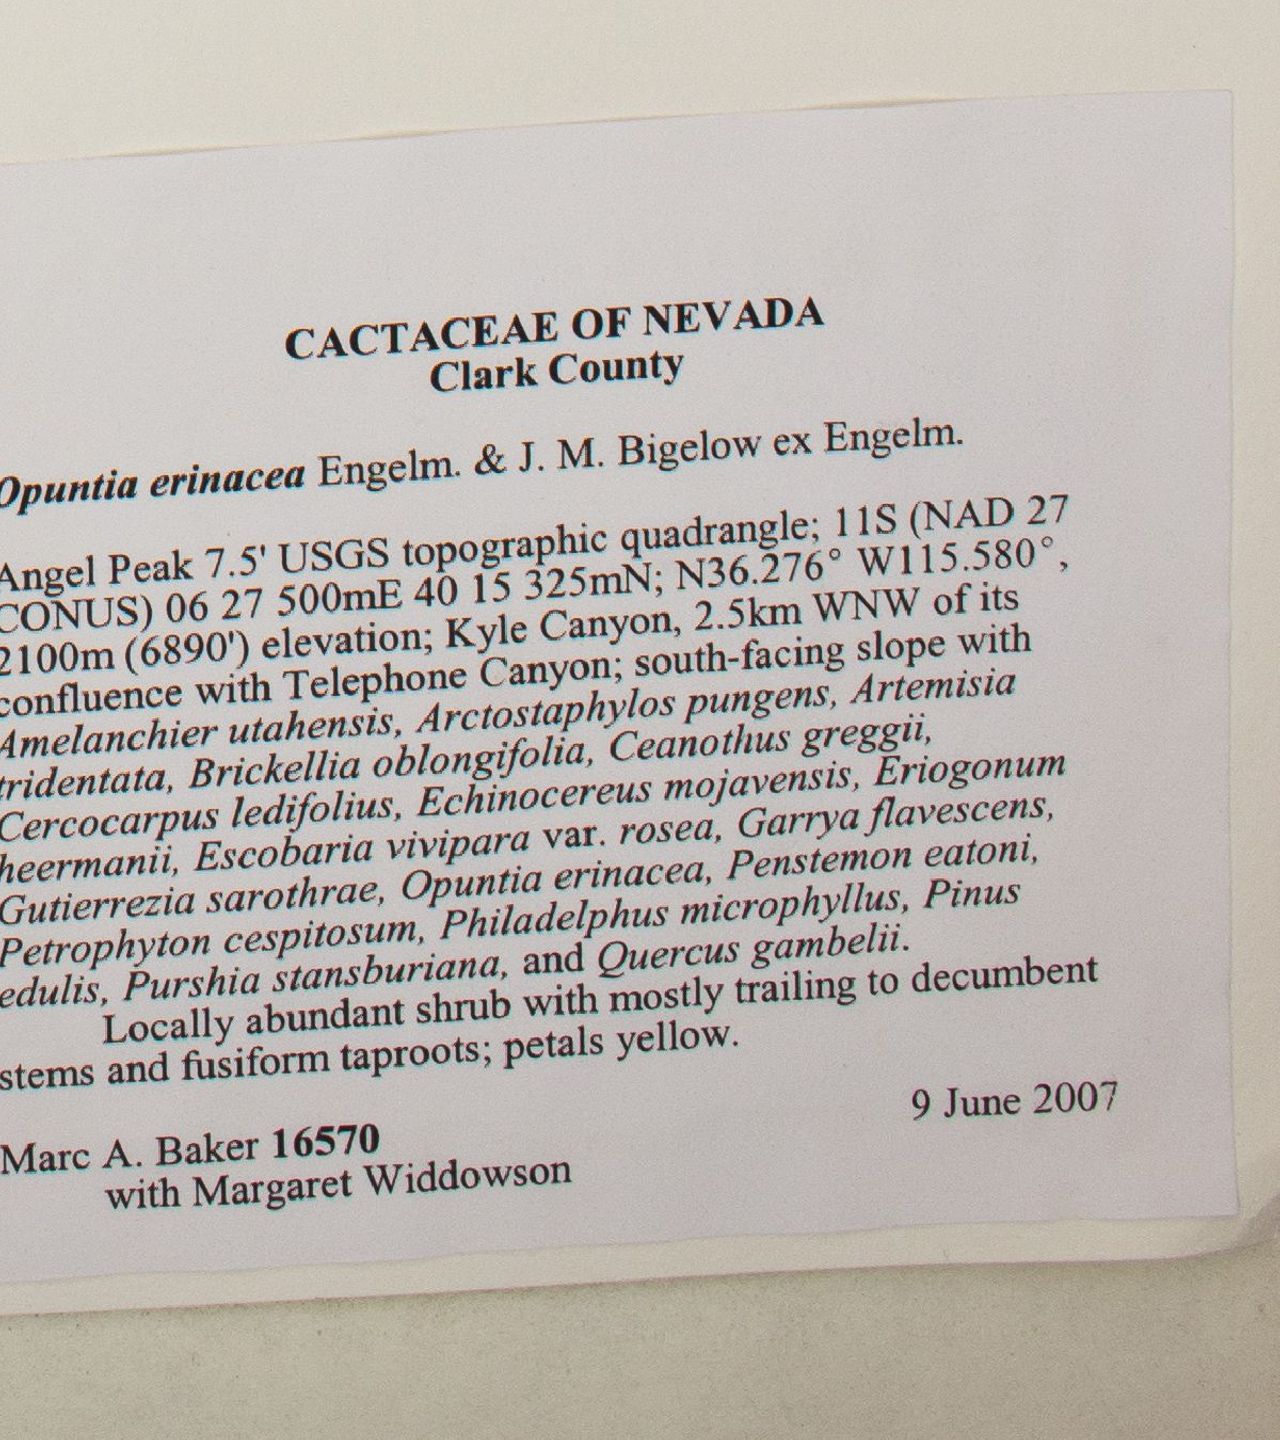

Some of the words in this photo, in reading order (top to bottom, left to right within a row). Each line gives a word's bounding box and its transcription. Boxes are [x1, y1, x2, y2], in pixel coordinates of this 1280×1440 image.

[285, 311, 558, 360] CACTACEAE
[572, 307, 631, 340] OF
[643, 297, 825, 336] NEVADA
[430, 357, 538, 393] Clark
[549, 350, 684, 386] County
[150, 464, 305, 497] erinacea
[318, 448, 460, 492] Engelm.
[475, 444, 507, 475] &
[519, 441, 544, 473] J.
[557, 438, 603, 470] M.
[618, 429, 762, 472] Bigelow
[774, 433, 811, 455] ex
[823, 417, 963, 459] Engelm.
[108, 549, 194, 584] Peak
[205, 544, 265, 578] 7.5'
[278, 538, 389, 573] USGS
[402, 522, 607, 573] topographic
[621, 509, 819, 560] quadrangle;
[837, 504, 896, 537] 11S
[910, 497, 1014, 540] (NAD
[1027, 494, 1068, 525] 27
[125, 630, 249, 676] (6890')
[262, 622, 432, 659] elevation;
[446, 614, 527, 655] Kyle
[540, 610, 681, 645] Canyon,
[695, 597, 802, 631] 2.5km
[812, 587, 920, 622] WNW
[934, 583, 972, 616] of
[980, 582, 1019, 611] its
[166, 591, 208, 623] 06
[222, 588, 262, 620] 27
[278, 579, 402, 617] 500mE
[414, 575, 458, 607] 40
[474, 571, 510, 604] 15
[525, 562, 662, 600] 325mN;
[195, 672, 272, 704] with
[282, 662, 467, 704] Telephone
[480, 657, 622, 691] Canyon;
[635, 636, 844, 676] south-facing
[857, 630, 945, 668] slope
[957, 622, 1032, 654] with
[230, 707, 401, 744] utahensis,
[415, 687, 675, 733] Arctostaphylos
[684, 685, 836, 724] pungens,
[850, 668, 1016, 704] Artemisia
[188, 750, 360, 789] Brickellia
[373, 735, 593, 781] oblongifolia,
[610, 723, 790, 761] Ceanothus
[801, 713, 931, 758] greggii,
[232, 790, 401, 833] ledifolius,
[417, 782, 652, 816] Echinocereus
[664, 761, 859, 807] mojavensis,
[874, 755, 1065, 790] Eriogonum
[194, 834, 372, 871] Escobaria
[387, 829, 529, 865] vivipara
[543, 825, 605, 849] var.
[620, 819, 721, 844] rosea,
[739, 807, 859, 840] Garrya
[864, 796, 1053, 837] flavescens,
[206, 876, 384, 913] sarothrae,
[402, 865, 542, 908] Opuntia
[554, 860, 711, 890] erinacea,
[727, 848, 911, 880] Penstemon
[925, 833, 1037, 867] eatoni,
[224, 920, 424, 960] cespitosum,
[440, 898, 669, 940] Philadelphus
[681, 882, 908, 926] microphyllus,
[923, 878, 1020, 909] Pinus
[123, 965, 260, 1001] Purshia
[272, 953, 507, 992] stansburiana,
[524, 941, 584, 975] and
[598, 941, 740, 979] Quercus
[751, 922, 909, 969] gambelii.
[102, 1007, 234, 1047] Locally
[247, 997, 405, 1035] abundant
[417, 988, 511, 1024] shrub
[523, 983, 598, 1016] with
[609, 976, 724, 1015] mostly
[735, 970, 856, 1006] trailing
[867, 970, 898, 996] to
[912, 955, 1098, 992] decumbent
[108, 1051, 170, 1084] and
[181, 1046, 330, 1080] fusiform
[340, 1037, 491, 1078] taproots;
[503, 1025, 603, 1069] petals
[617, 1020, 738, 1062] yellow.
[912, 1089, 930, 1121] 9
[944, 1088, 1021, 1118] June
[1033, 1081, 1118, 1114] 2007
[0, 1142, 90, 1175] Marc
[102, 1139, 142, 1168] A.
[155, 1132, 259, 1166] Baker
[273, 1123, 379, 1158] 16570
[104, 1177, 181, 1209] with
[192, 1170, 352, 1211] Margaret
[363, 1159, 572, 1196] Widdowson
